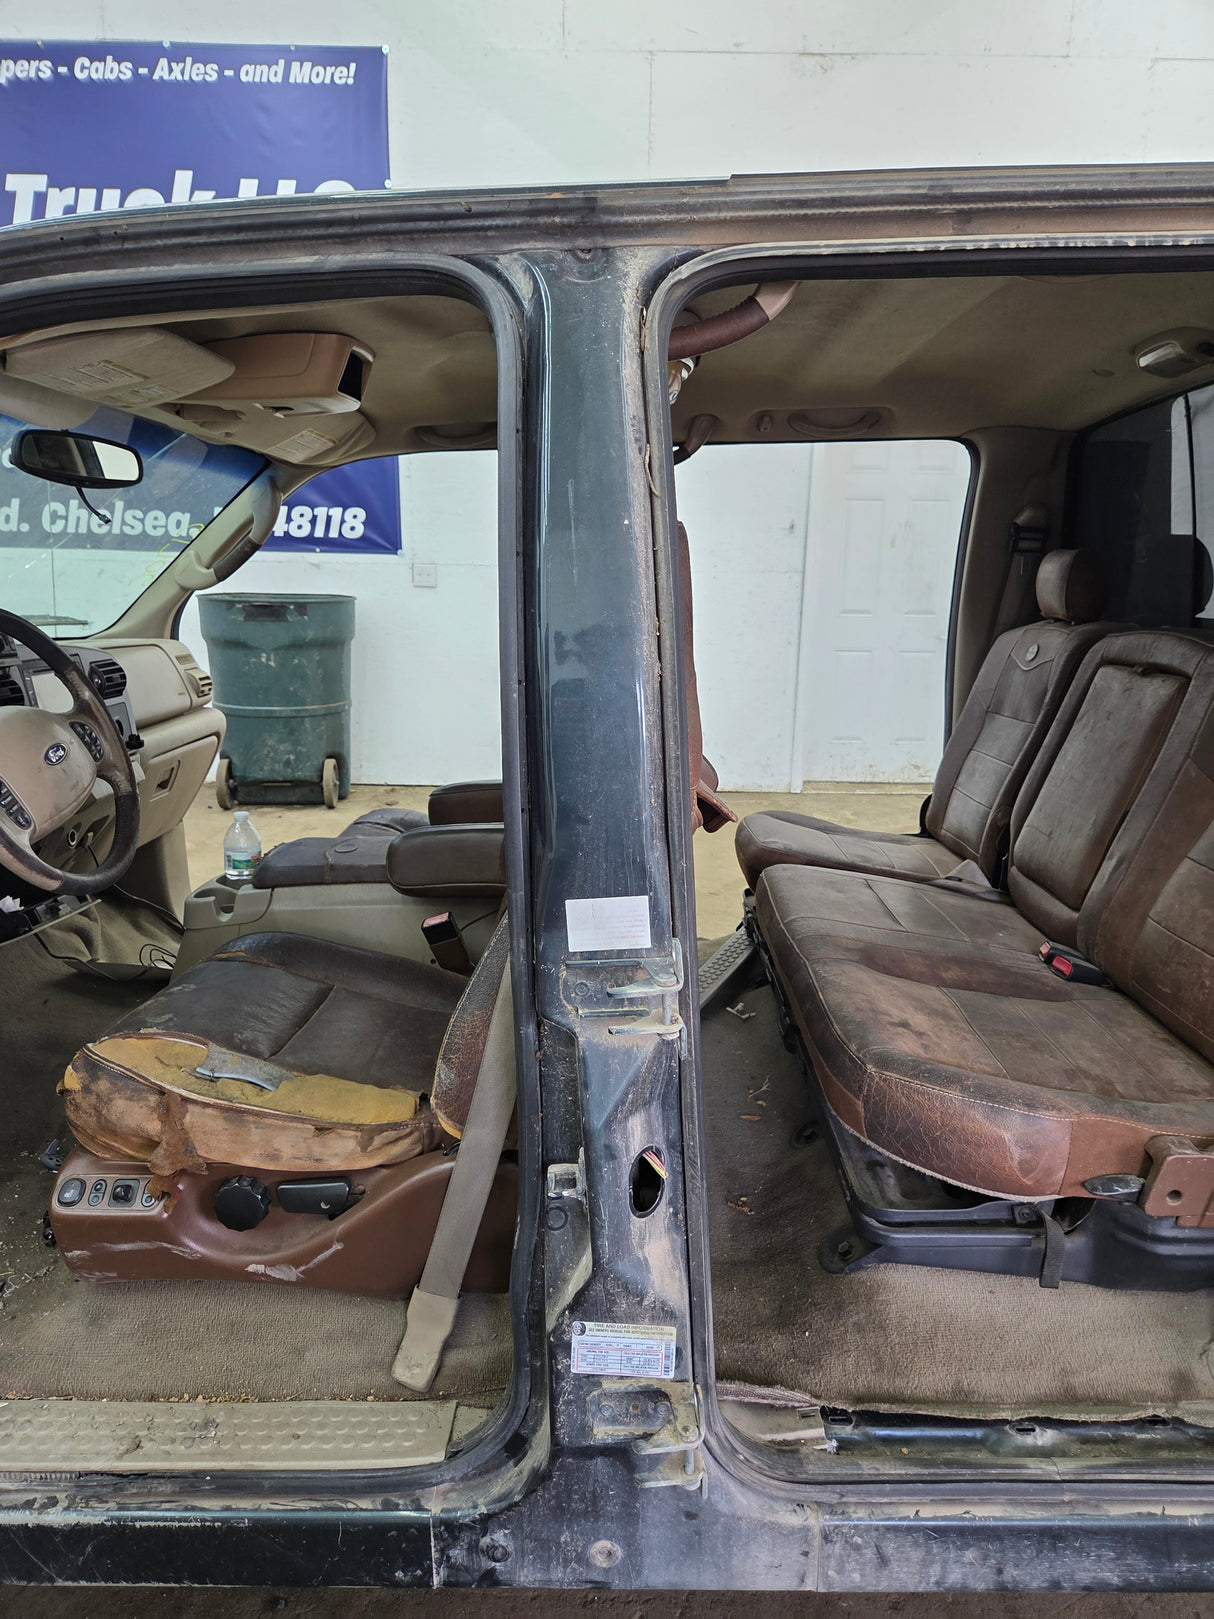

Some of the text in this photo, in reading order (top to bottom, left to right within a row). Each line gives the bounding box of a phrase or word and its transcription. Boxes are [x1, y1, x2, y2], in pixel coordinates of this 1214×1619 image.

[0, 59, 52, 84] pers
[74, 56, 132, 80] Cabs
[153, 57, 218, 81] Axles
[240, 59, 285, 83] and
[289, 61, 356, 84] More!
[273, 505, 366, 539] 48118
